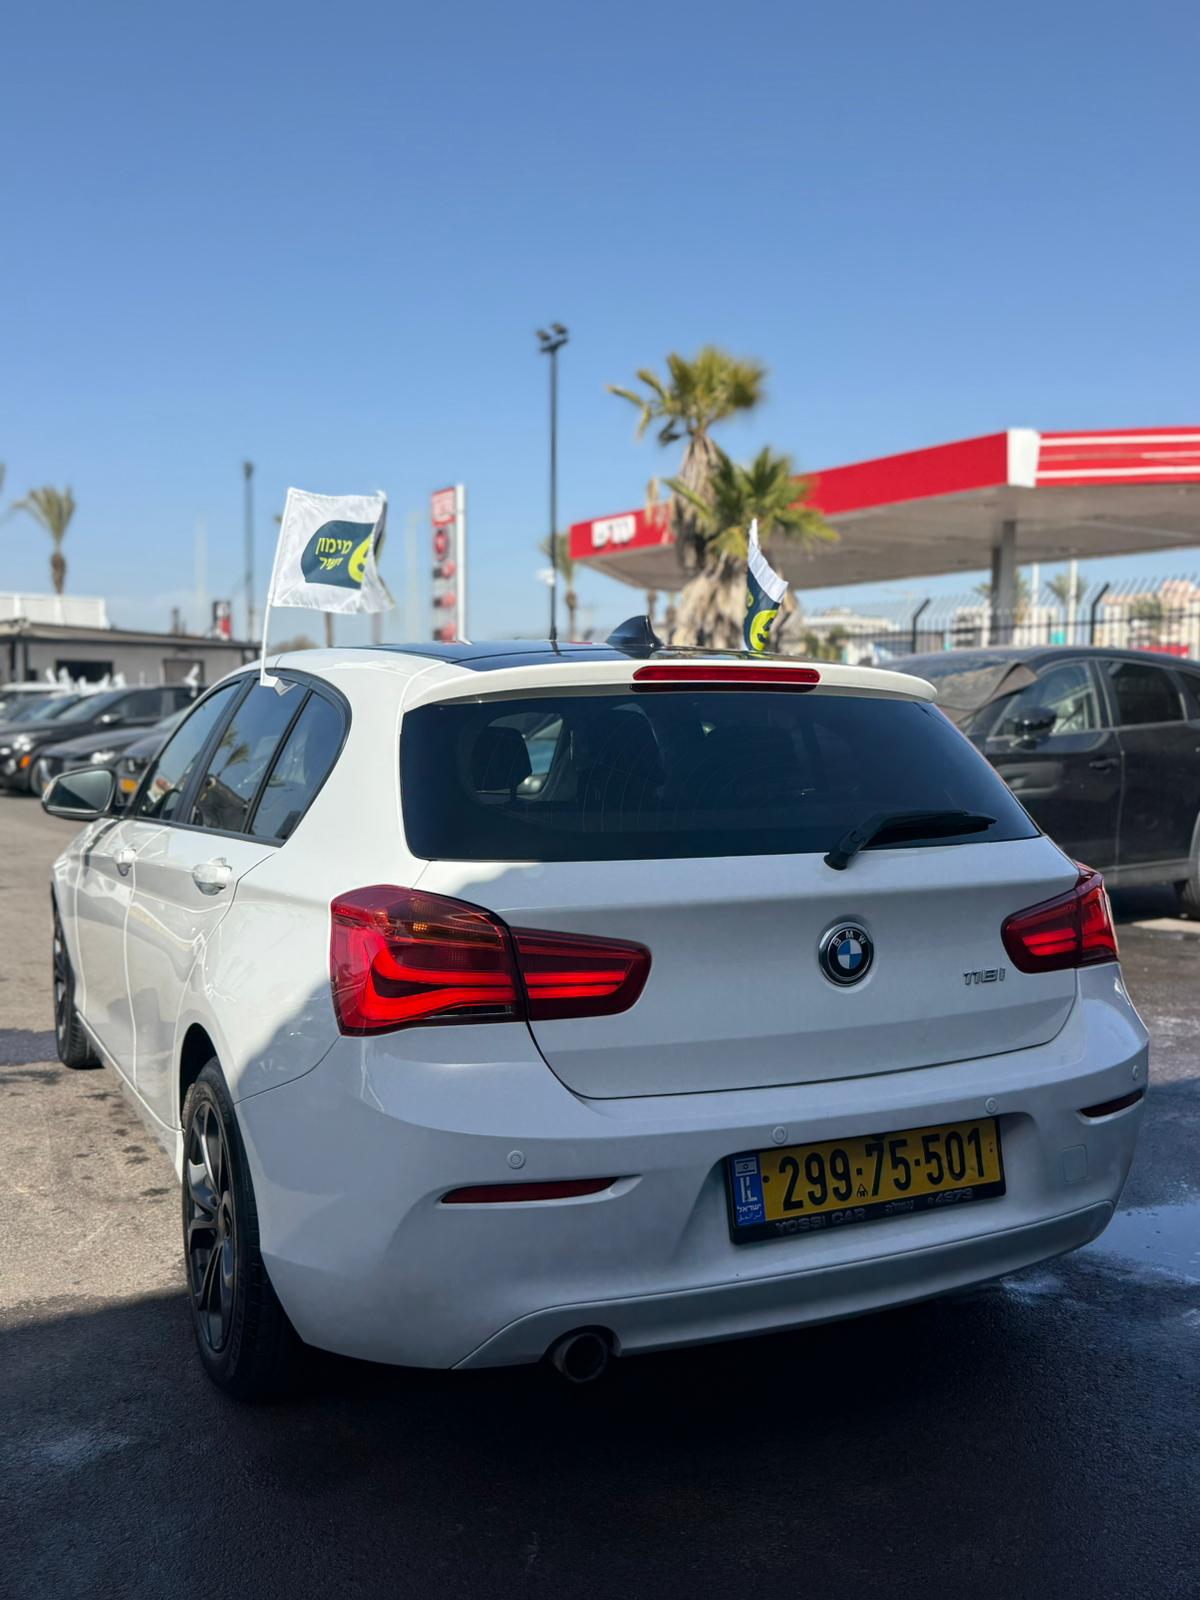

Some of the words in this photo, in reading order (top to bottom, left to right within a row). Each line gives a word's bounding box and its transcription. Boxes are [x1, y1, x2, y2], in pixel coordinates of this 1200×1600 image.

[315, 537, 353, 555] מימון
[832, 930, 867, 947] BMW
[963, 967, 1006, 986] 118i
